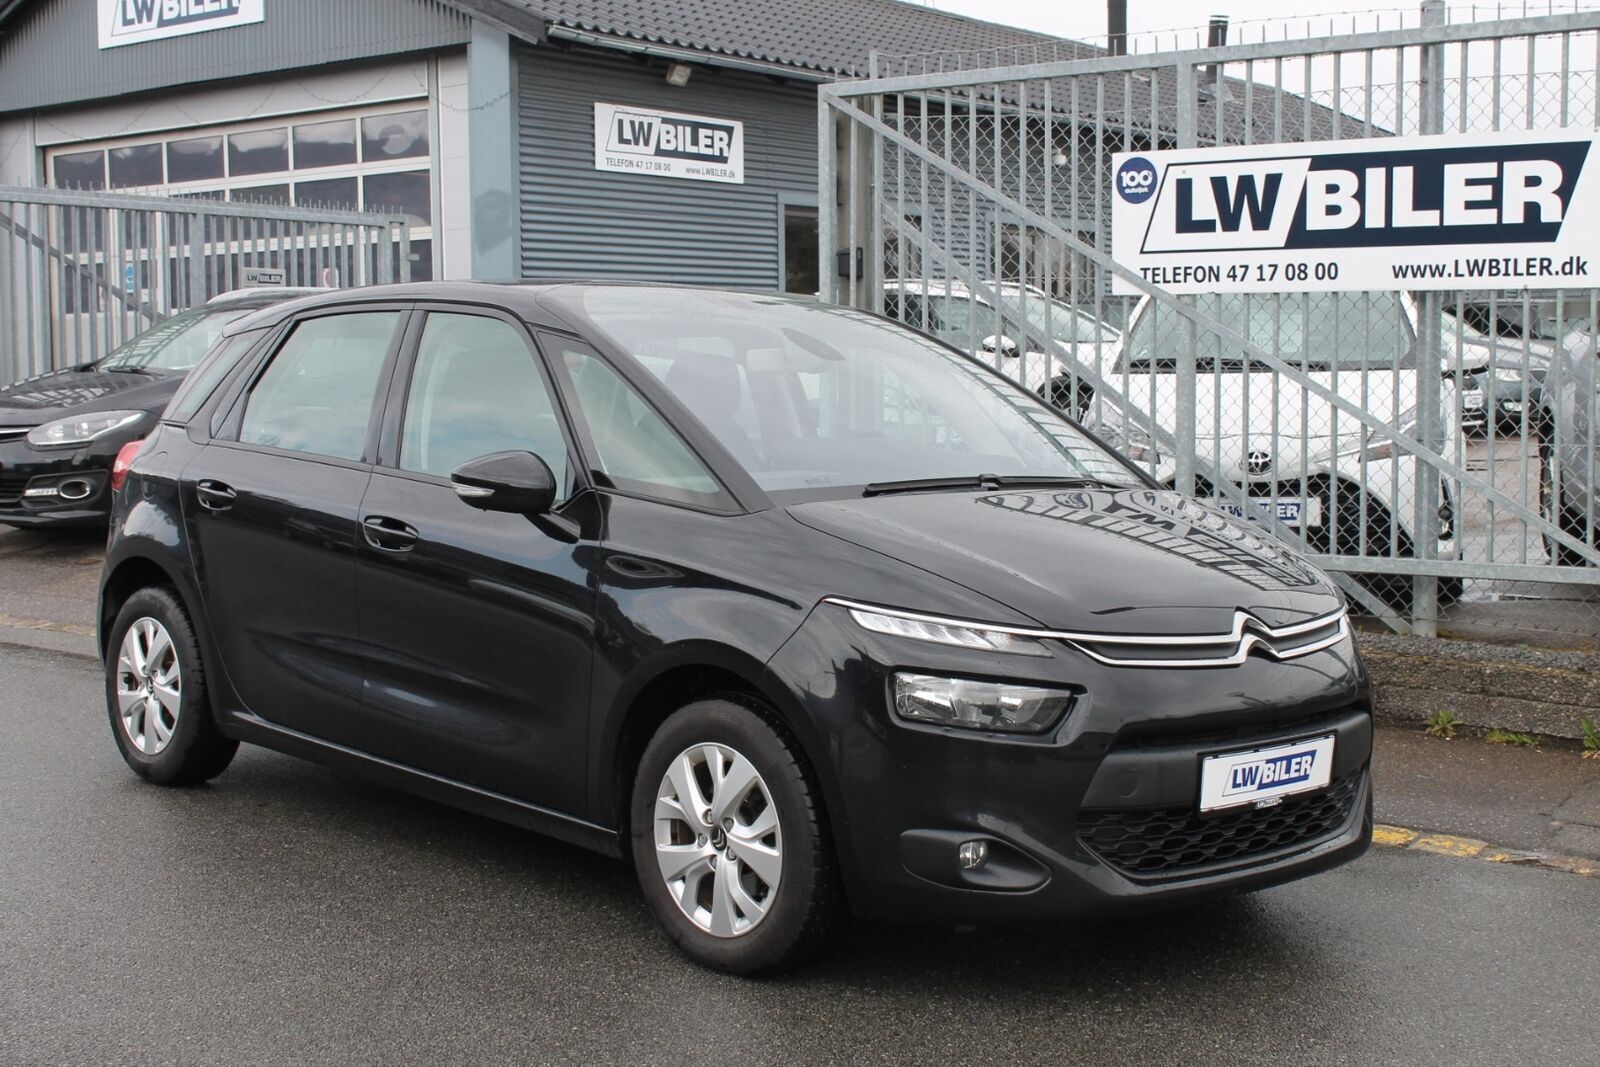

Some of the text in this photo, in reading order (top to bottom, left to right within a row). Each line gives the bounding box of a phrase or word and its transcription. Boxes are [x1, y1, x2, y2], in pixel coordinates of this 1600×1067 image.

[660, 123, 729, 157] BILER
[606, 157, 634, 168] TELEFON
[635, 160, 643, 169] 47
[685, 167, 735, 178] www.LWBILER.dk
[1305, 159, 1563, 231] BILER
[1140, 262, 1339, 284] TELEFON 47 17 08 00
[1392, 256, 1588, 279] www.LWBILER.dk
[1262, 755, 1312, 784] BILER
